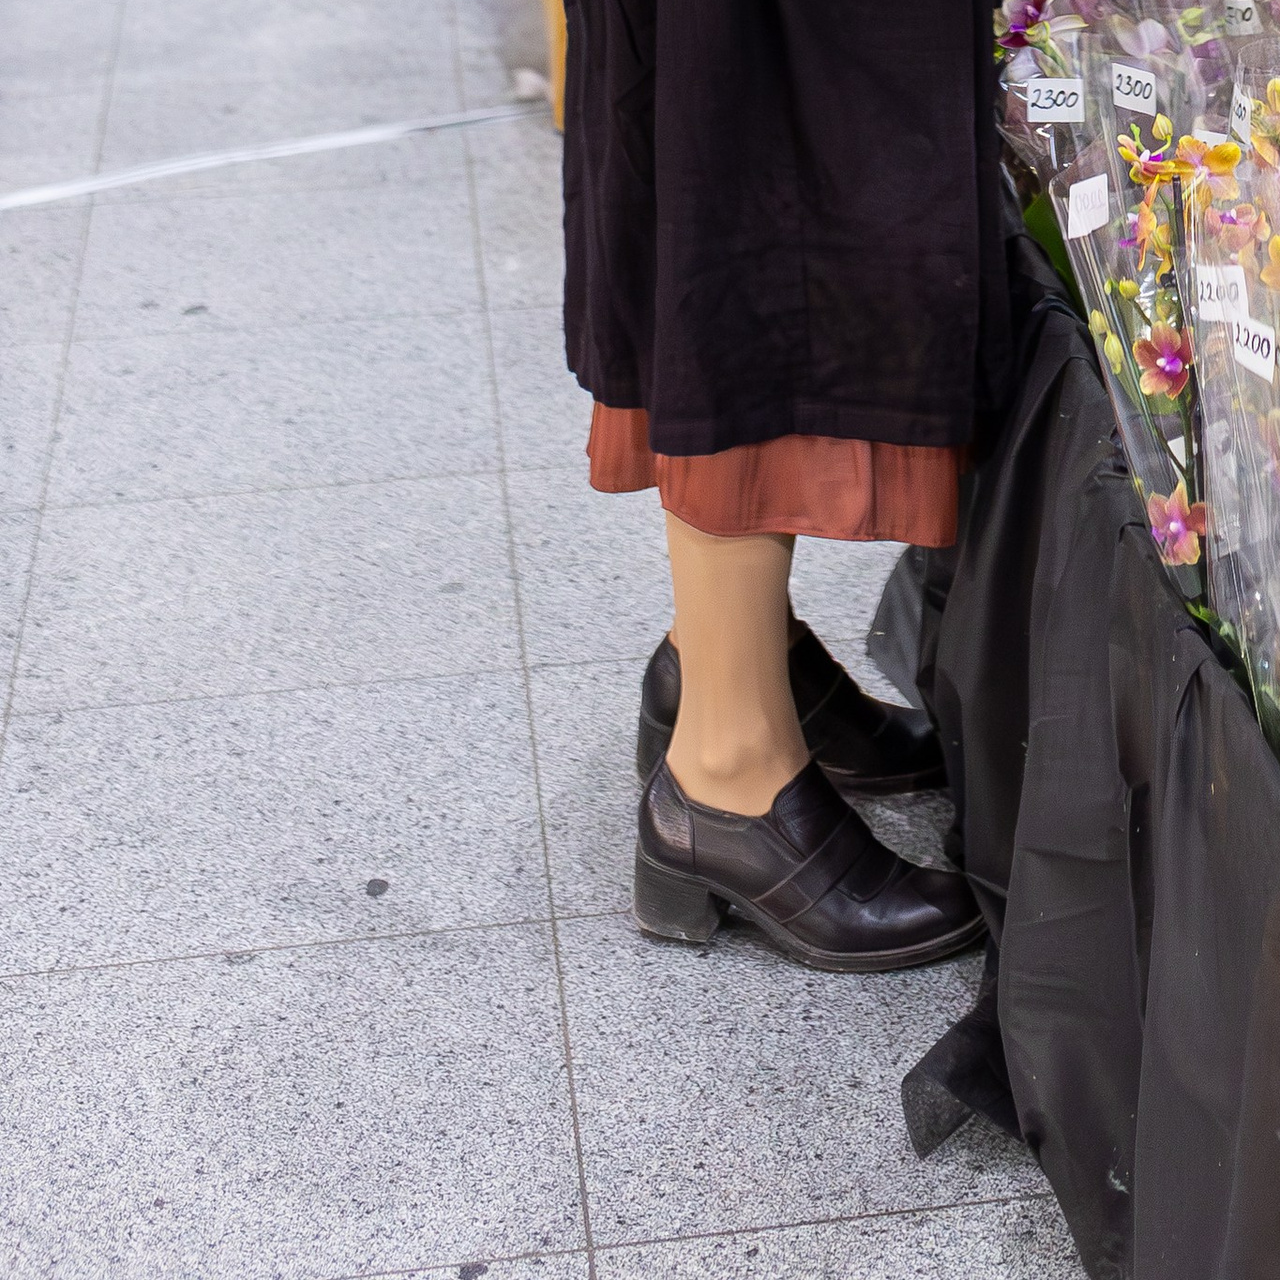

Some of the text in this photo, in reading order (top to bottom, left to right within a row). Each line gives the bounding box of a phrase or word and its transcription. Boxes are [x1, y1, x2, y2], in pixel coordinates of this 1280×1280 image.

[1031, 88, 1079, 109] 2300
[1115, 73, 1153, 100] 2300
[1200, 280, 1239, 303] 2200
[1235, 322, 1271, 359] 2200
